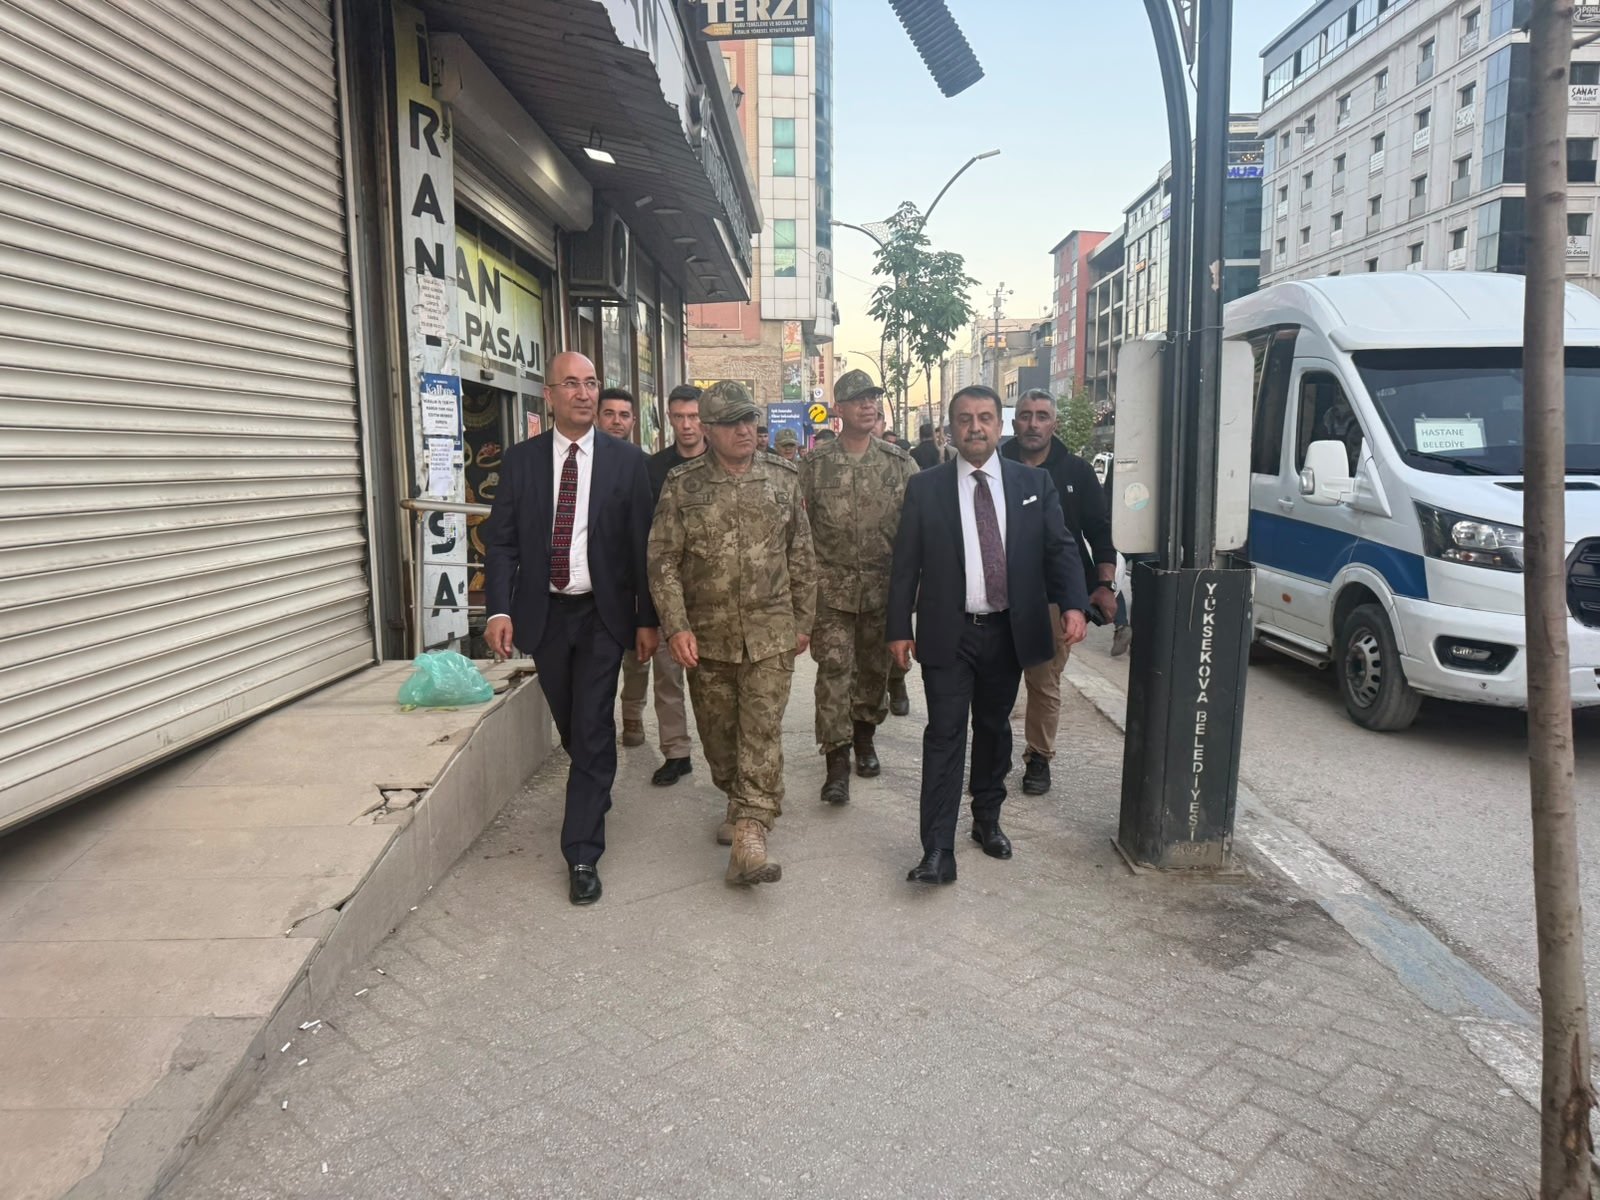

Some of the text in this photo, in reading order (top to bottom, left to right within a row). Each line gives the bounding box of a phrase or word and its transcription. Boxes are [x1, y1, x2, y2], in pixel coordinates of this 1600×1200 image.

[1421, 428, 1464, 436] HASTANE
[1423, 440, 1465, 448] BELEDİYE
[1189, 582, 1218, 841] YÜKSEKOVA BELEDİYESİ
